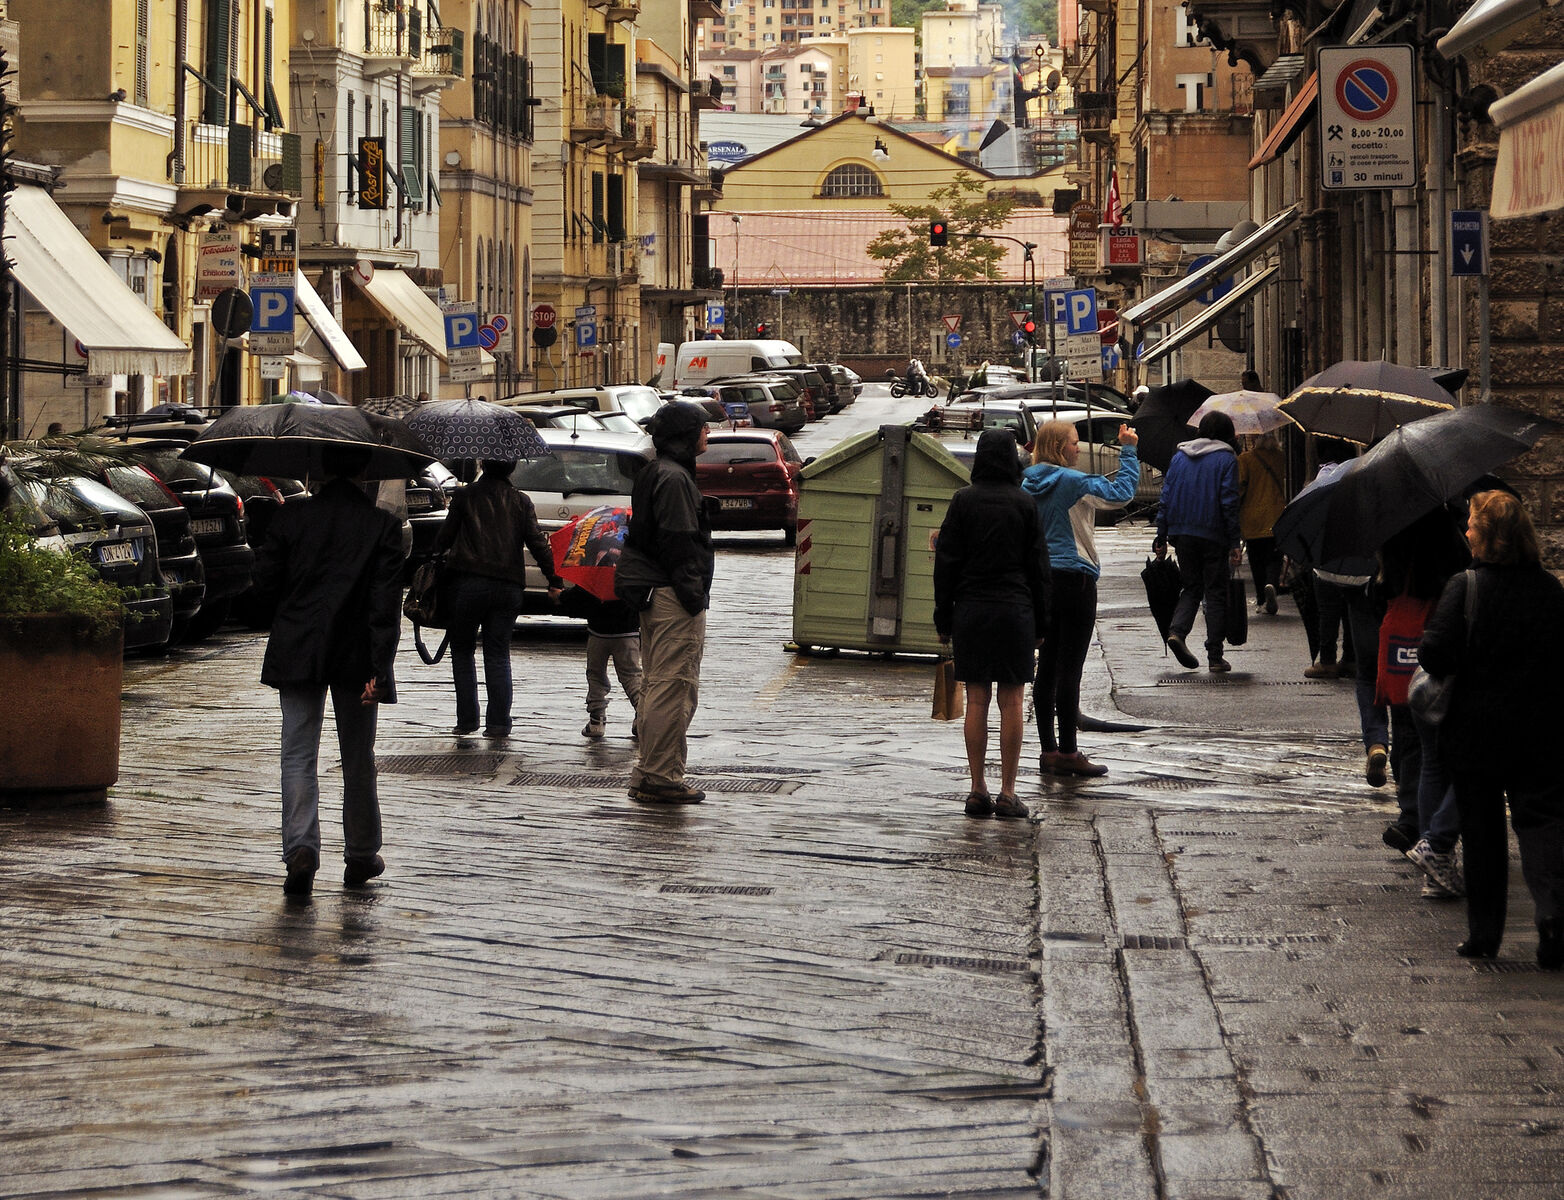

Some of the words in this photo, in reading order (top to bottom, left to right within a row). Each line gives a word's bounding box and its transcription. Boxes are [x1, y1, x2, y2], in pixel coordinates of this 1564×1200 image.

[1351, 142, 1383, 150] eccetto
[1353, 173, 1367, 181] 30
[1373, 172, 1403, 181] minuti
[1109, 227, 1138, 236] CGIL
[269, 230, 288, 251] T
[201, 244, 238, 256] Totocalcio
[220, 258, 235, 266] Tris
[260, 292, 288, 327] P
[534, 311, 555, 321] STOP
[711, 307, 722, 323] P
[1071, 294, 1092, 330] P
[451, 317, 473, 345] P
[581, 325, 593, 344] P
